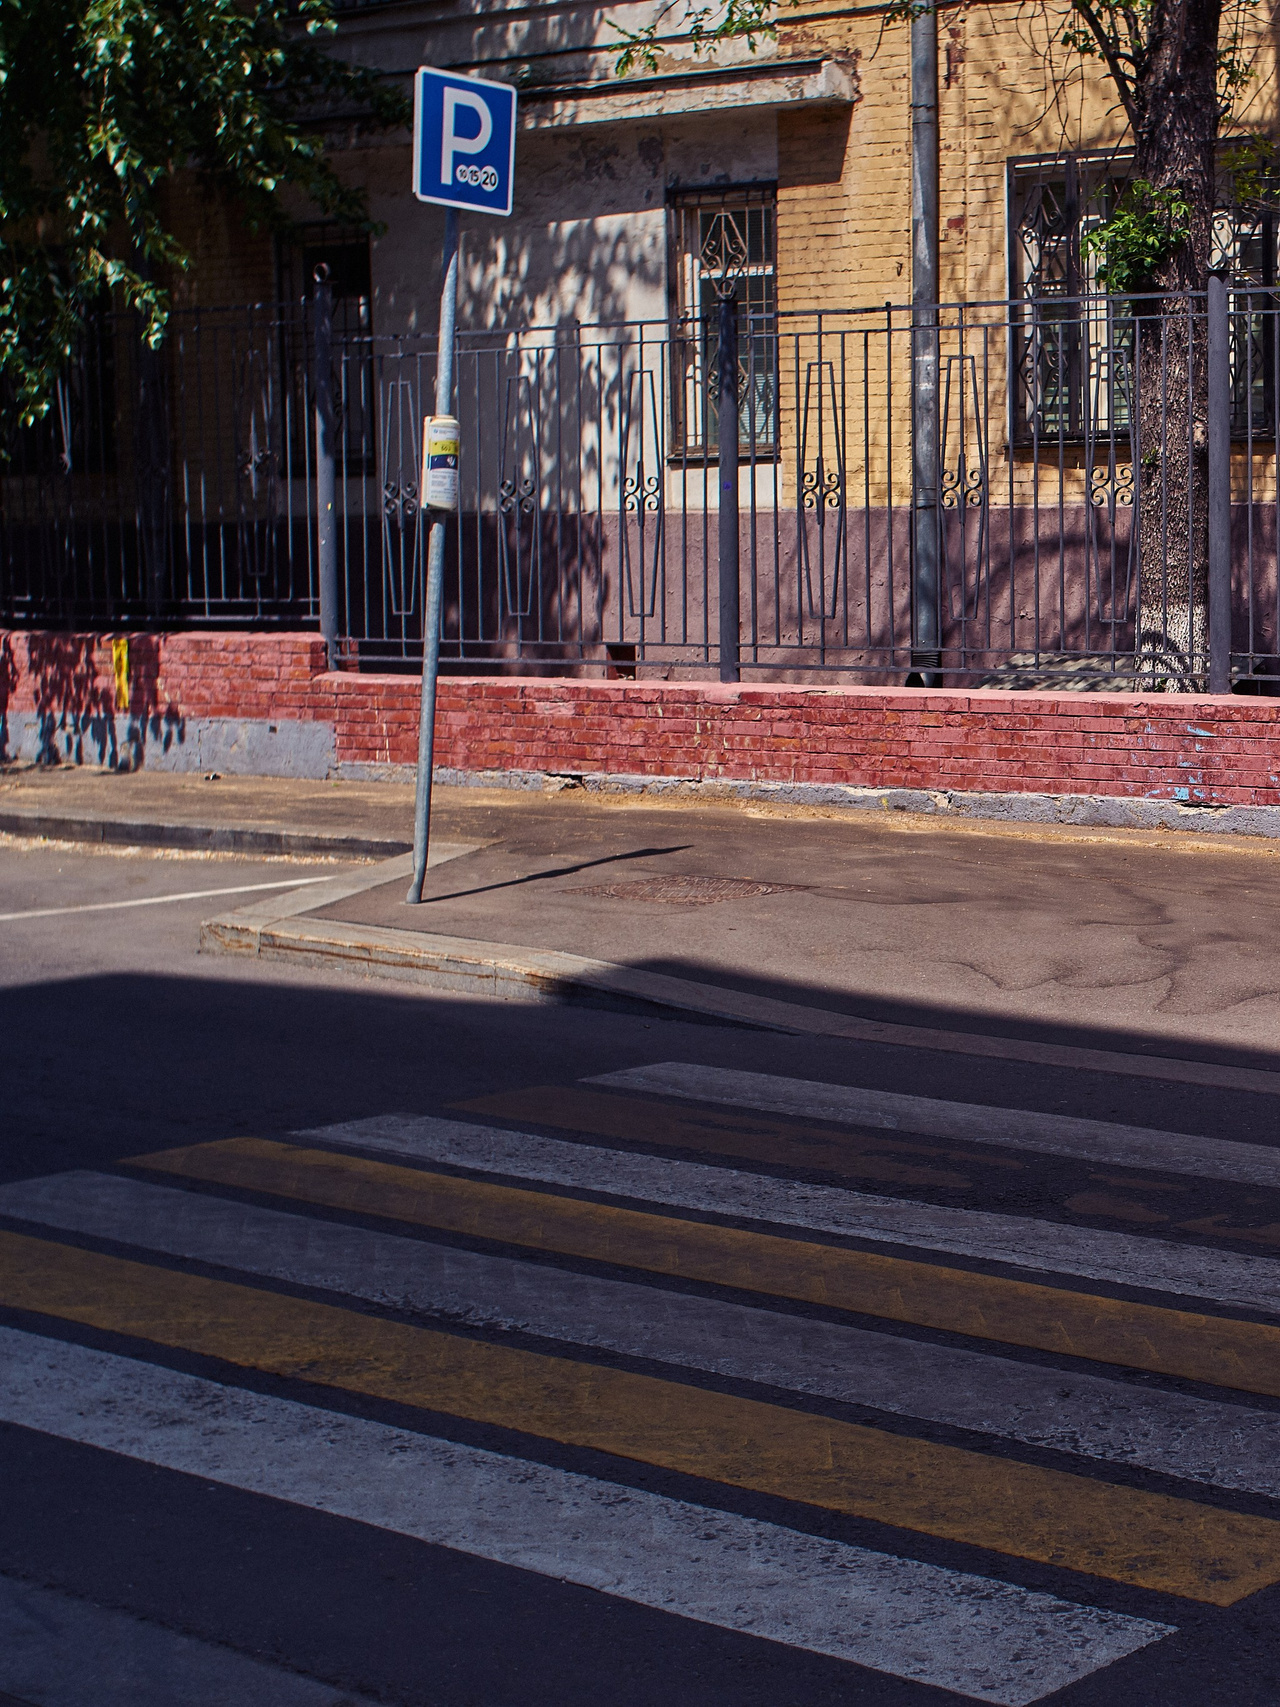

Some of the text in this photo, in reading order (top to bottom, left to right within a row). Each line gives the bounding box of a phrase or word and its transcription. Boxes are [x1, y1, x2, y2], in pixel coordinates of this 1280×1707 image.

[441, 86, 492, 186] P
[469, 170, 479, 182] 15
[482, 172, 497, 187] 20
